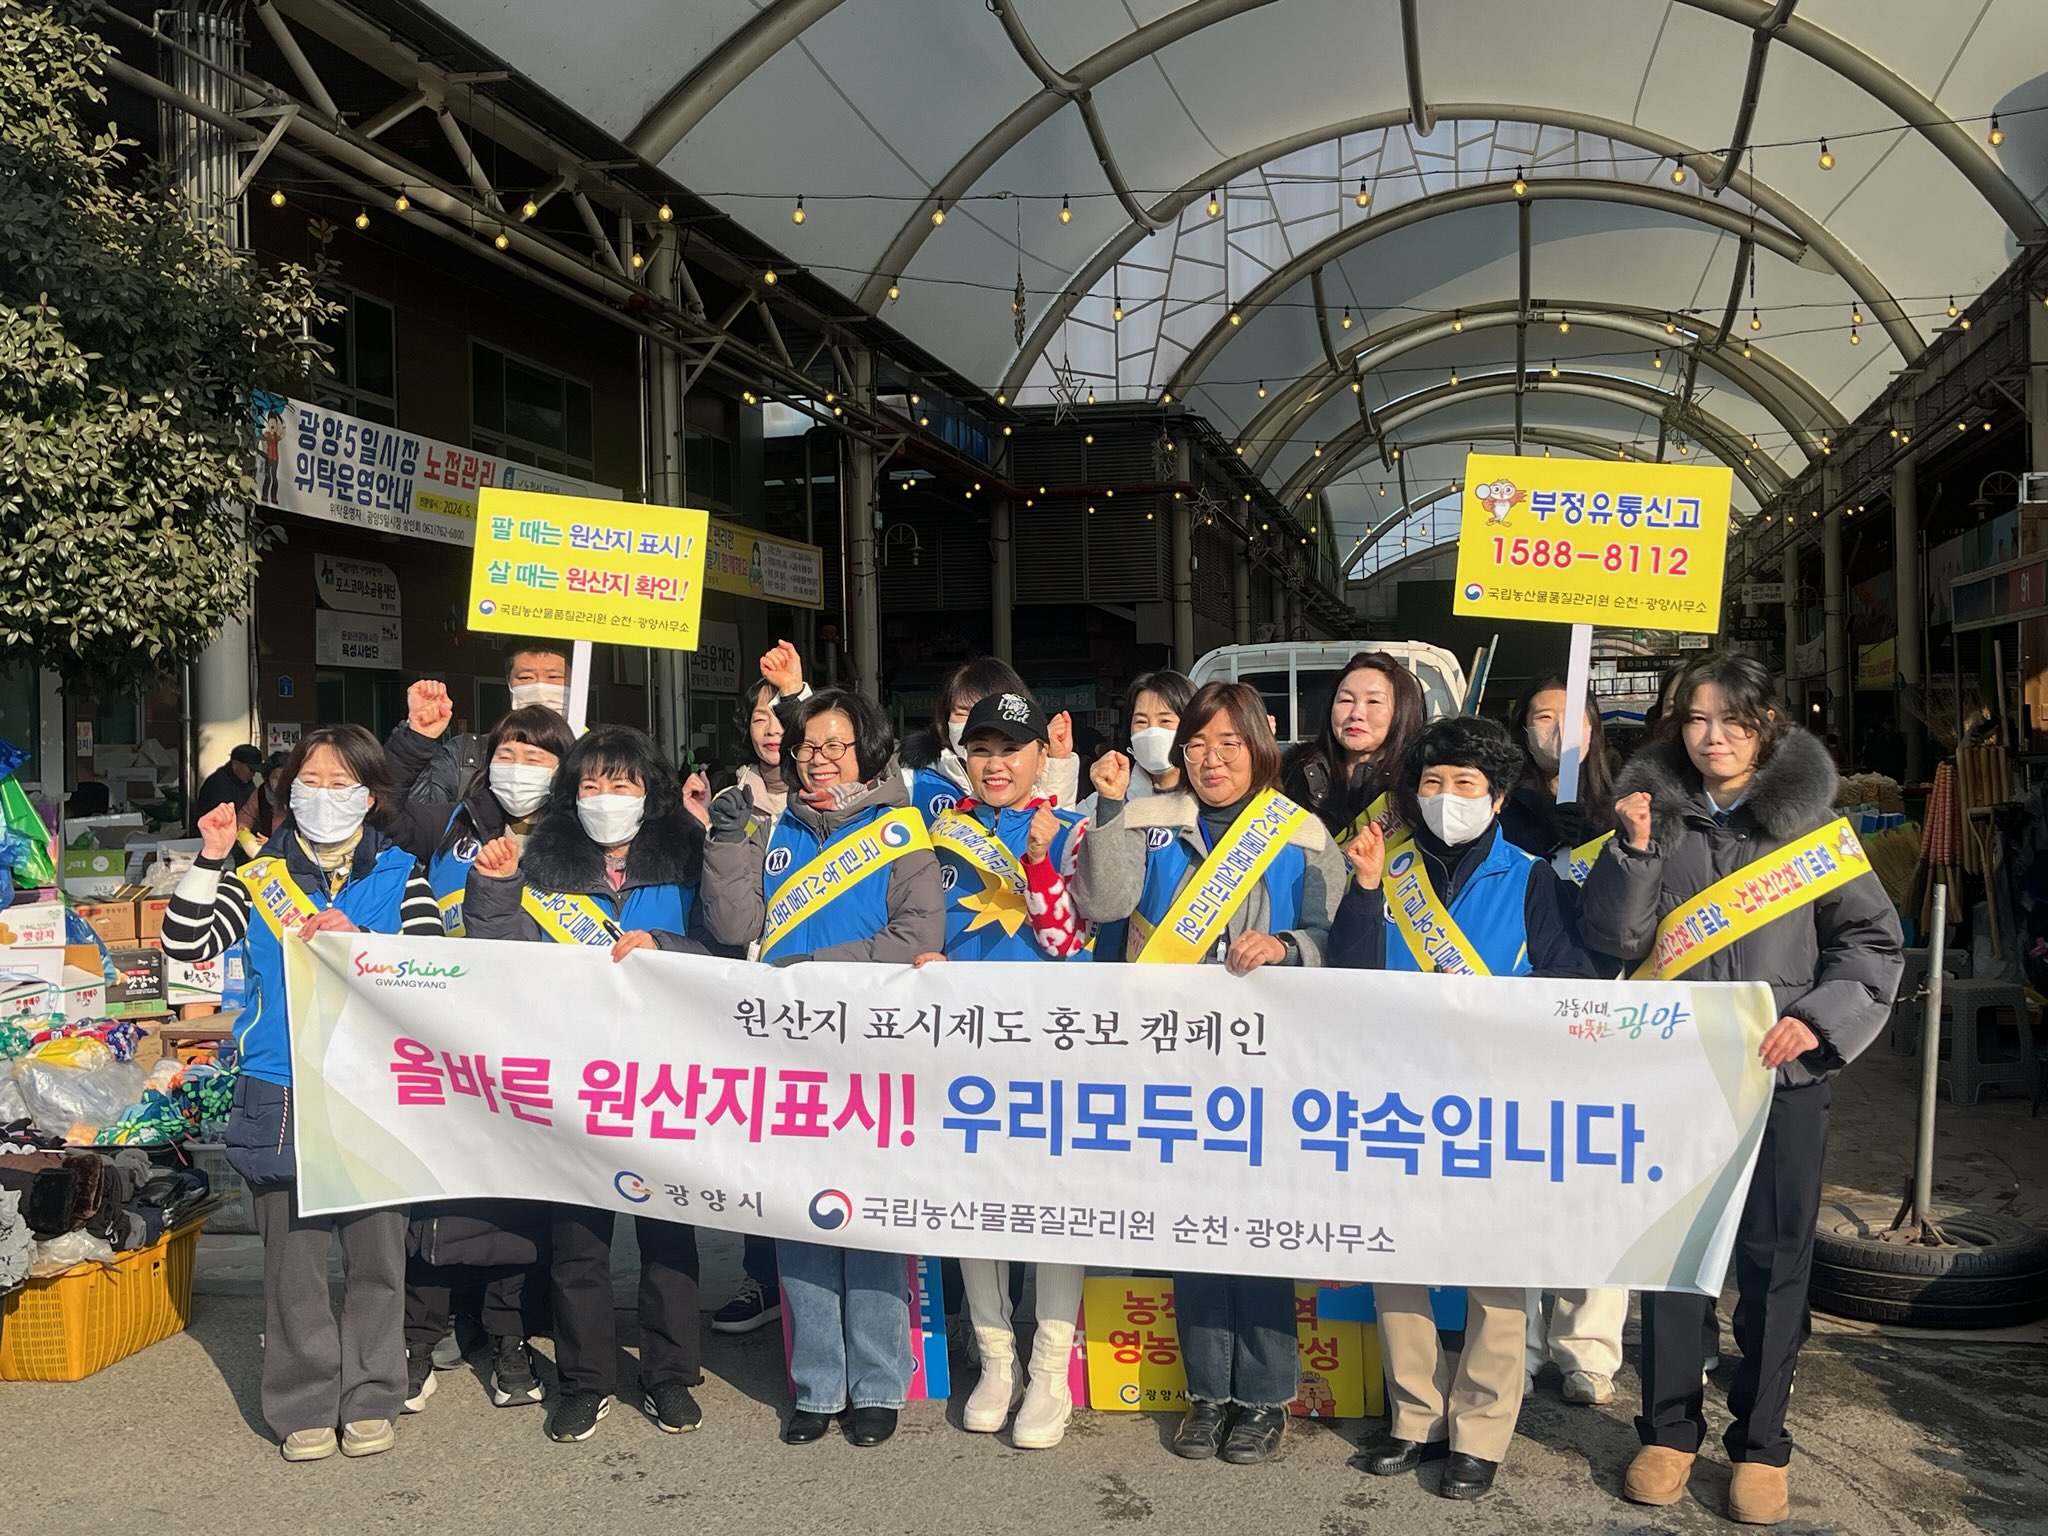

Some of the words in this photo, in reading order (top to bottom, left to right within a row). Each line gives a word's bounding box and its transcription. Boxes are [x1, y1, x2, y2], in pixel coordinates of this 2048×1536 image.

[298, 410, 420, 476] 광양5일시장
[424, 447, 496, 490] 노점관리
[295, 453, 414, 514] 위탁운영안내
[1530, 491, 1700, 528] 부정유통신고
[491, 516, 515, 541] 팔
[520, 520, 563, 546] 때는
[568, 524, 632, 554] 원산지
[637, 532, 693, 559] 표시!
[1492, 537, 1689, 576] 1588-8112
[488, 560, 512, 584] 살
[516, 564, 560, 589] 때는
[566, 567, 629, 597] 원산지
[635, 575, 689, 602] 확인!
[1488, 588, 1610, 608] 국립농산물품질관리원
[2020, 572, 2030, 602] 91
[500, 604, 607, 624] 국립농산물품질관리원
[342, 643, 379, 659] 육성사업단
[23, 929, 55, 942] 햇감자
[354, 950, 471, 979] Sunshine
[375, 978, 447, 990] GWANGYANG
[733, 997, 848, 1045] 원산지
[864, 1003, 1032, 1050] 표시제도
[1041, 1006, 1129, 1050] 홍보
[1140, 1009, 1267, 1056] 캠페인
[1568, 1018, 1614, 1042] 따뜻한
[1614, 1002, 1690, 1040] 광양
[390, 1037, 555, 1127] 올바른
[577, 1059, 916, 1149] 원산지표시!
[942, 1074, 1264, 1167] 우리모두의
[1291, 1088, 1664, 1184] 약속입니다.
[862, 1196, 1156, 1241] 국립농산물품질관리원
